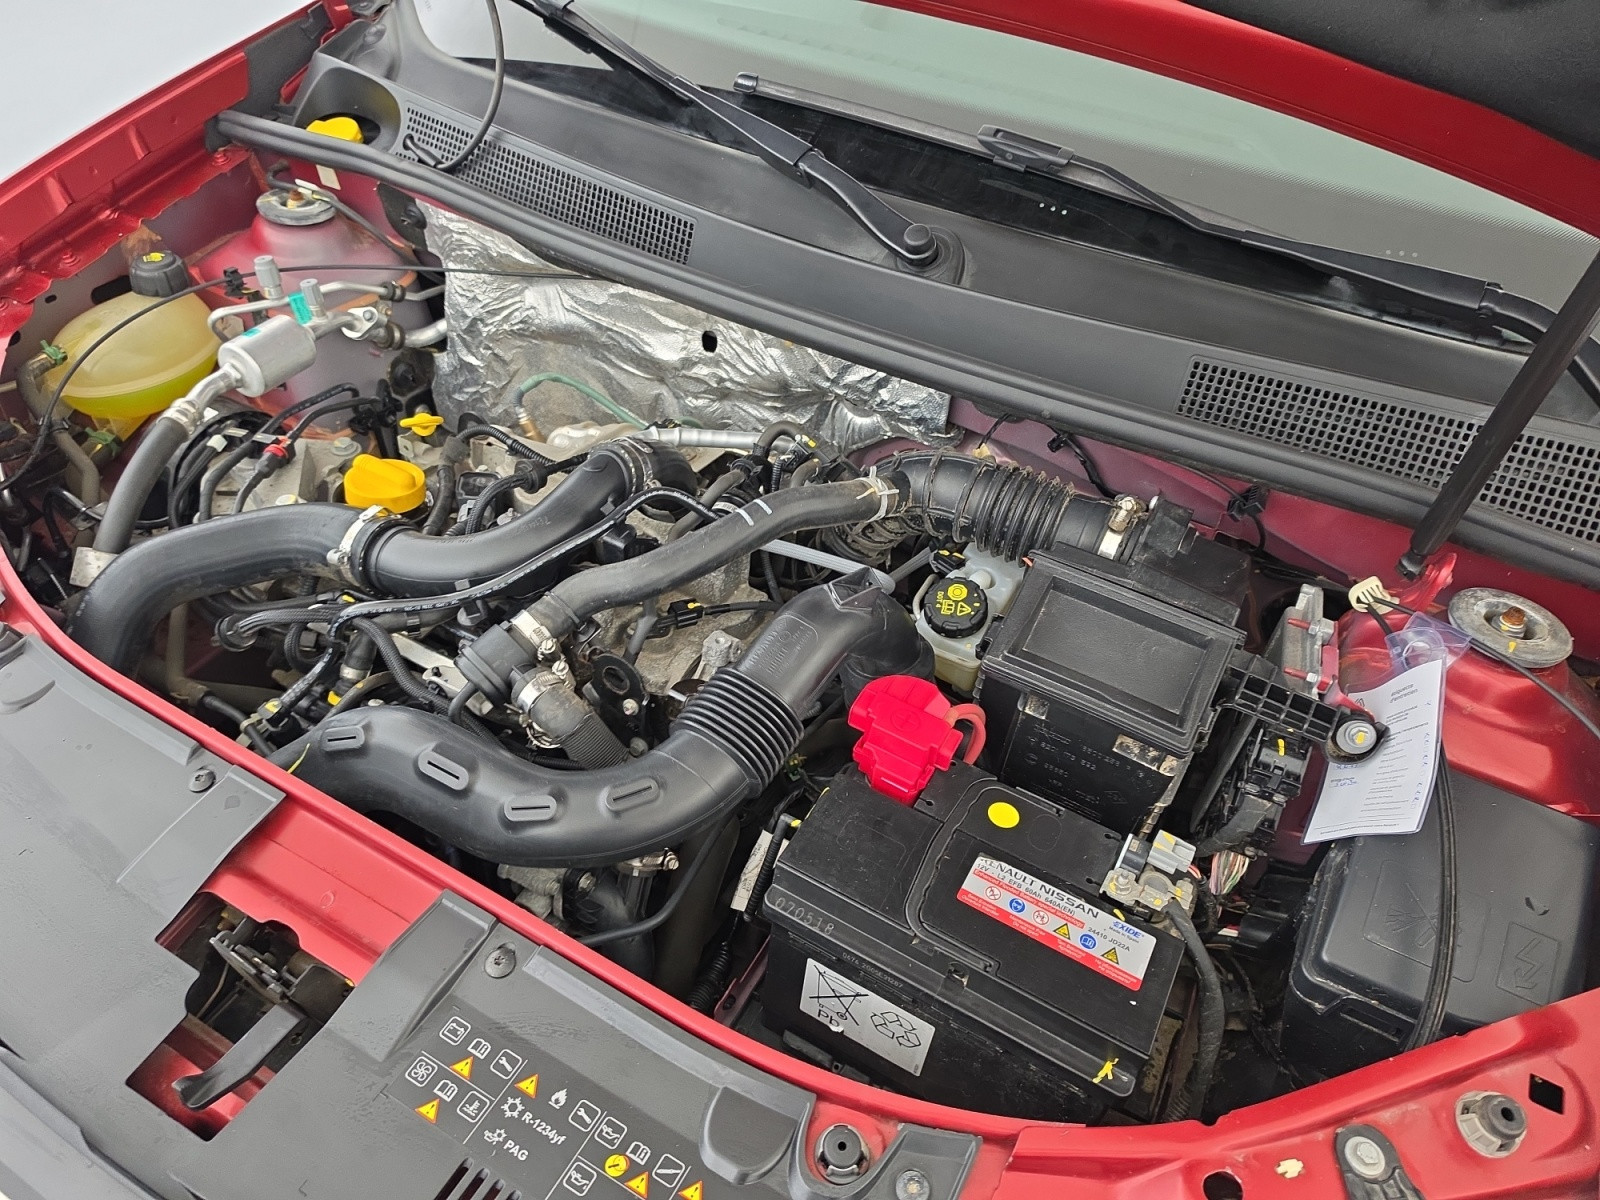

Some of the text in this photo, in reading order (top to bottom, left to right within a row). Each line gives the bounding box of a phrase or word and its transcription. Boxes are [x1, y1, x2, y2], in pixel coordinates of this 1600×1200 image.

[976, 863, 989, 872] 12V
[1008, 878, 1022, 888] EFB
[1024, 886, 1042, 898] 60Ah
[1043, 896, 1076, 916] 640A(EN)
[1040, 884, 1099, 918] NISSAN
[774, 897, 835, 936] 070518
[1111, 920, 1141, 938] EXIDE
[1087, 926, 1131, 951] 24410 JD22A
[817, 1009, 840, 1028] Pb
[522, 1112, 566, 1144] R-1234yf
[503, 1140, 528, 1161] PAG
